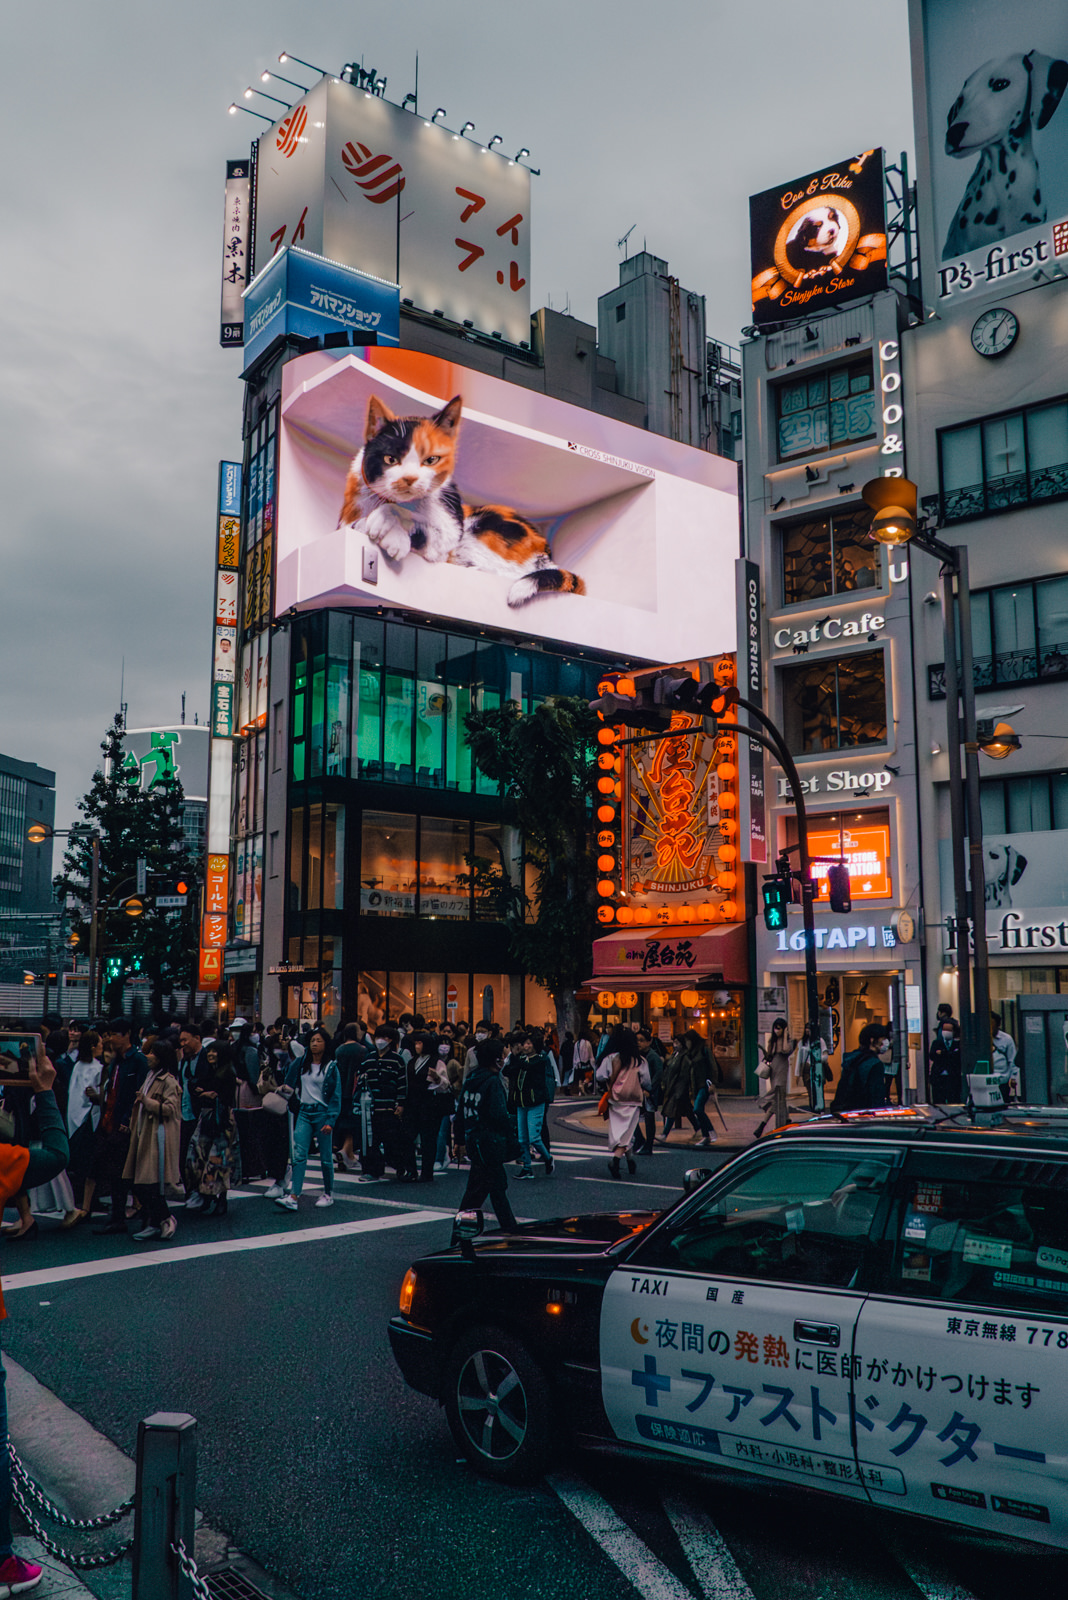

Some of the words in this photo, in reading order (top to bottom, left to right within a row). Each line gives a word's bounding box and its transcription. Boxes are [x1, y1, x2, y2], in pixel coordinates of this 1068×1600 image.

[781, 191, 804, 210] Coo
[807, 178, 818, 195] &
[820, 172, 853, 190] Riku
[224, 236, 245, 284] 黒木
[826, 277, 855, 294] Store
[310, 290, 381, 326] アパマンショップ
[579, 446, 601, 460] CROSS
[602, 453, 634, 470] SHINJUKU
[634, 464, 656, 478] VISION
[749, 579, 758, 621] COO
[750, 623, 758, 638] &
[750, 640, 759, 690] RIKU
[216, 685, 231, 736] 宝石広場
[826, 771, 891, 791] Shop
[852, 851, 877, 863] STORE
[650, 880, 704, 892] SHINJUKU
[776, 930, 807, 950] 16
[813, 926, 876, 949] TAPI
[631, 1277, 669, 1296] TAXI
[706, 1287, 745, 1305] 国産
[946, 1317, 1017, 1342] 東京無線
[1026, 1327, 1068, 1349] 778
[655, 1318, 1040, 1409] 夜間の発熱に医師がかけつけます
[681, 1368, 1046, 1467] ファストドクター
